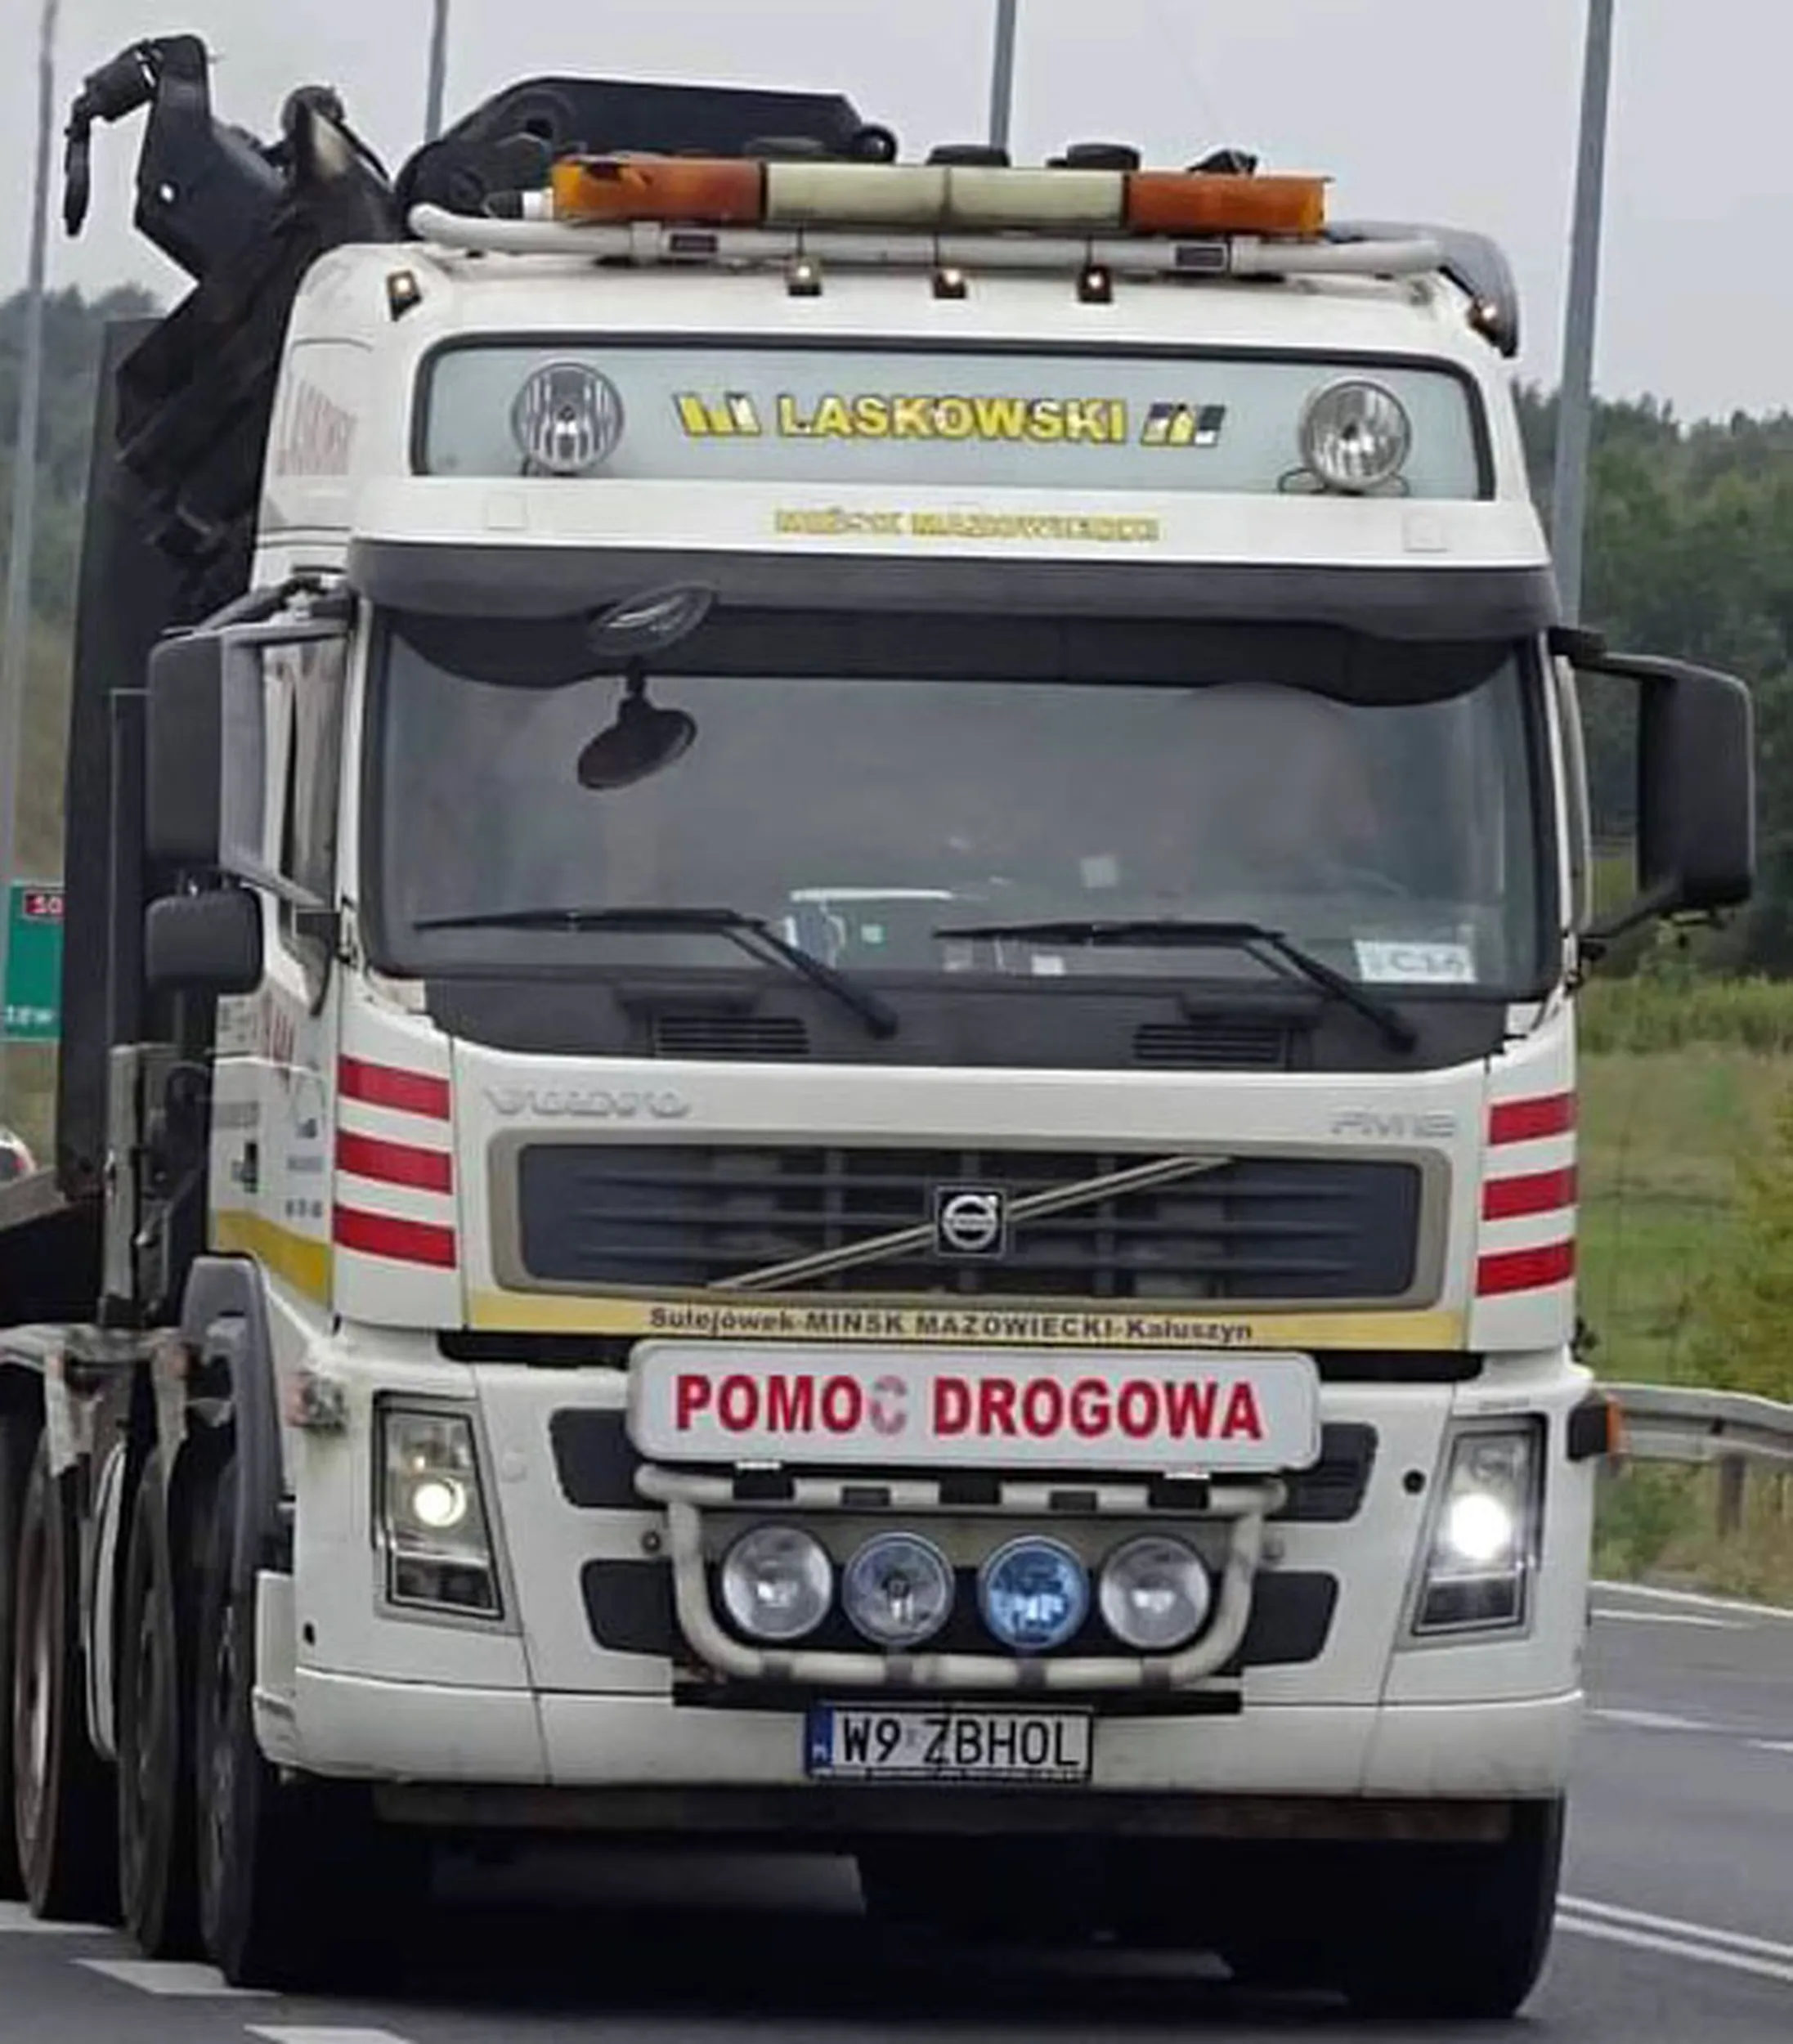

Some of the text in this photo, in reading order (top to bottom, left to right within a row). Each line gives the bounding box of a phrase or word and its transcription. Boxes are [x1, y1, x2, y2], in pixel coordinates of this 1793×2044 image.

[775, 392, 1127, 445] LASKOWSKI
[675, 1373, 1264, 1441] POMOC DROGOWA
[843, 1715, 901, 1764] W9
